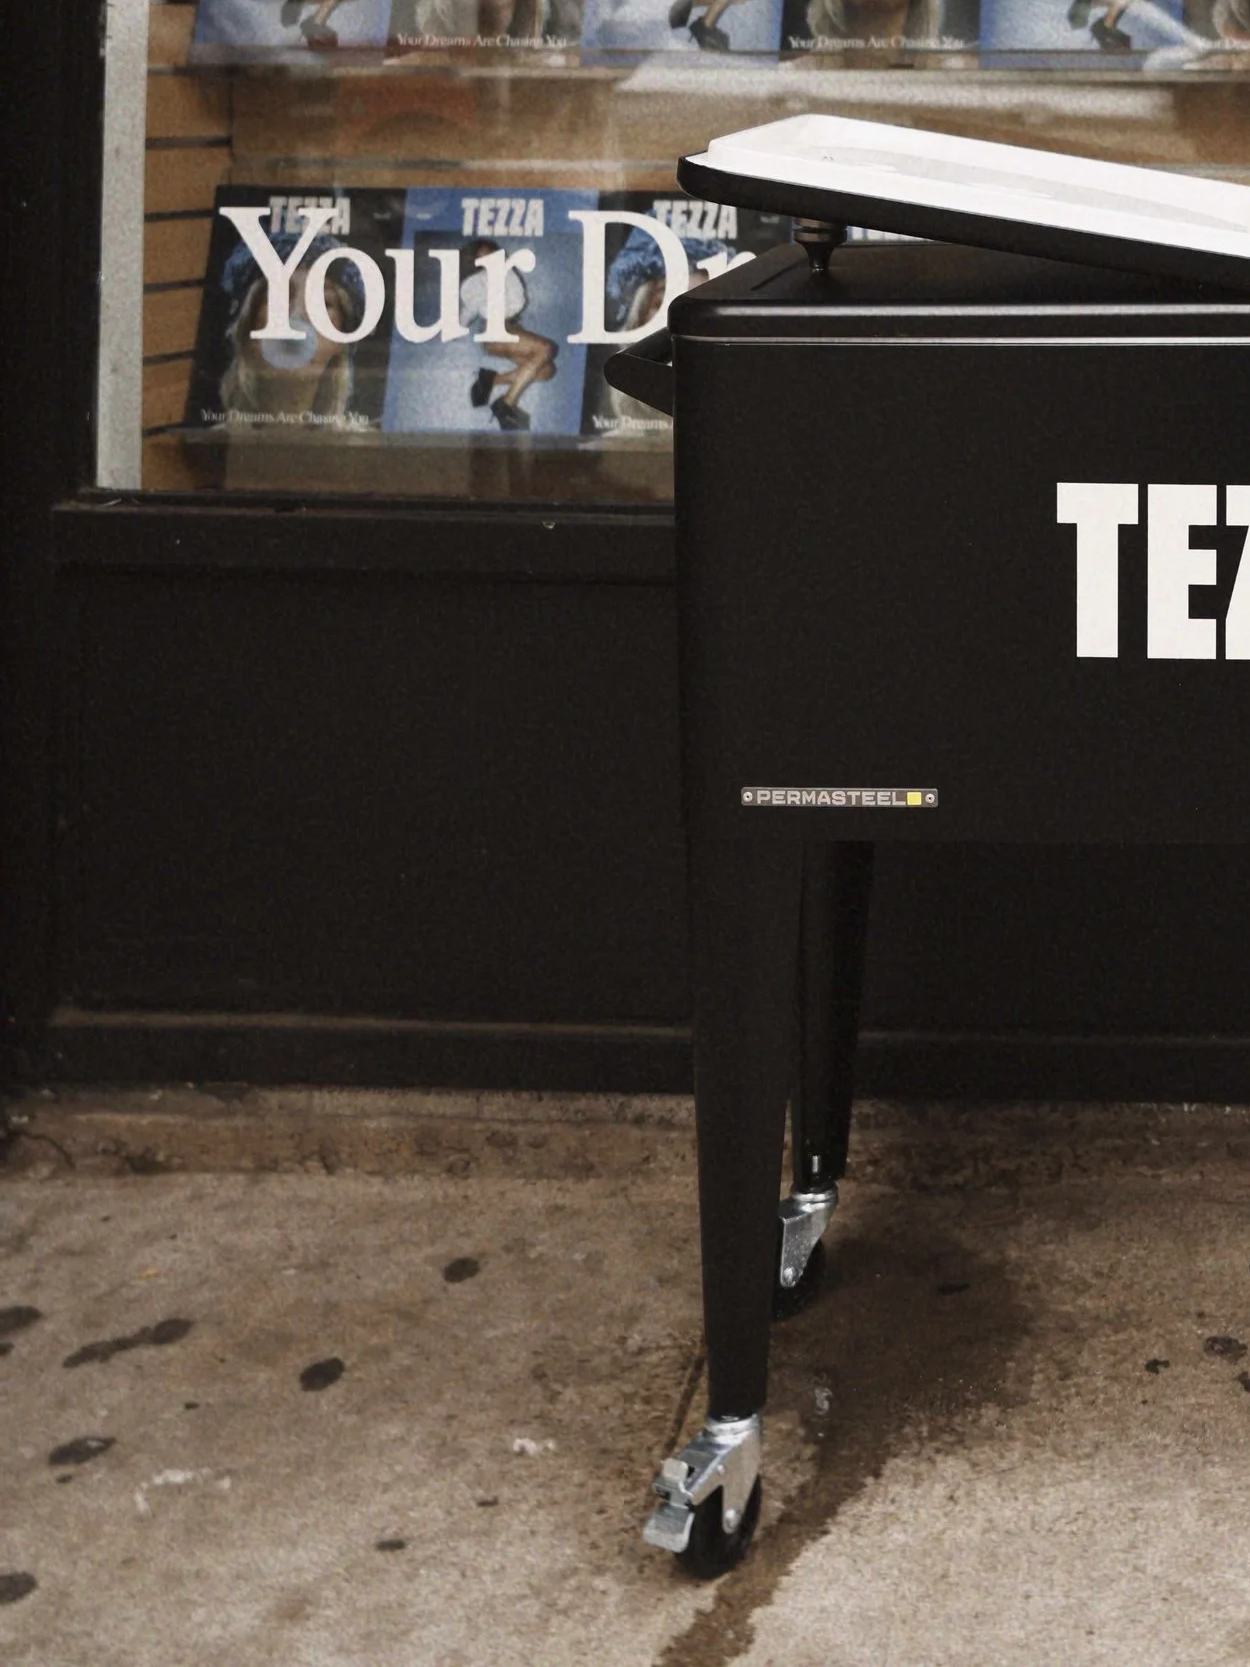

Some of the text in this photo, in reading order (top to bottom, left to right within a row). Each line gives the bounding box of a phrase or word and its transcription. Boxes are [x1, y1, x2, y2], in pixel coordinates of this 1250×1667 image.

[397, 34, 423, 46] Your
[473, 34, 495, 47] Are
[788, 36, 816, 48] Your
[461, 198, 544, 238] TEZZA
[219, 206, 537, 344] Your
[756, 789, 907, 806] PERMASTEEL
